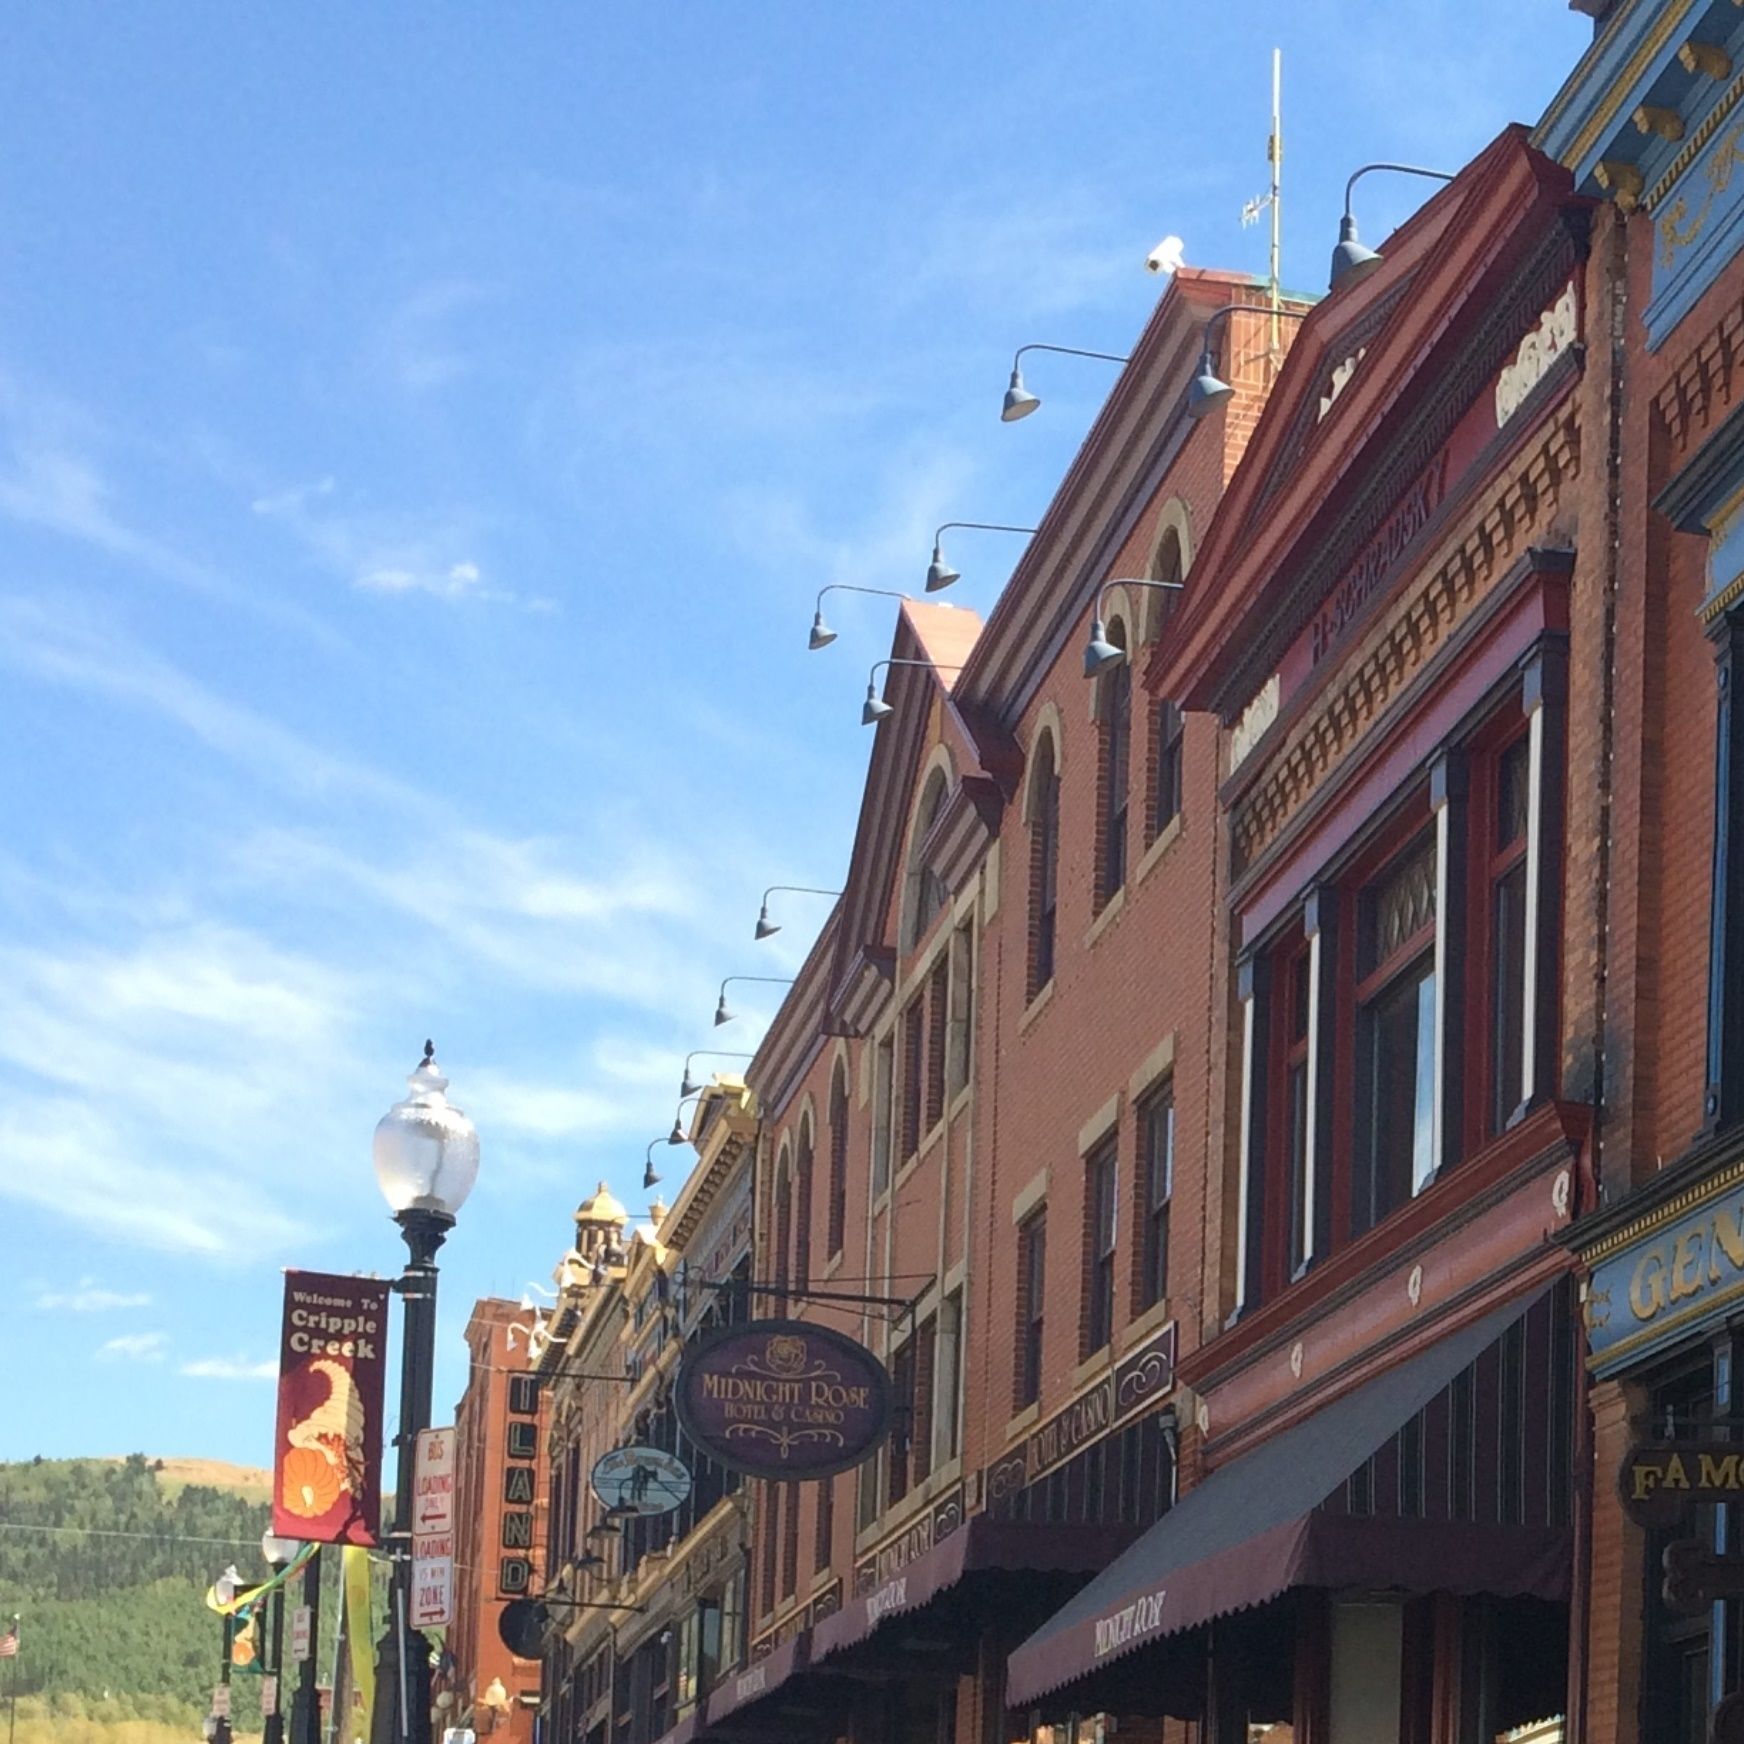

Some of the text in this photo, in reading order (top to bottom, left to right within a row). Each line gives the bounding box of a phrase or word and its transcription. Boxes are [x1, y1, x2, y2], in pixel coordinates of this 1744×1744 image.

[293, 1292, 378, 1310] Welcome To
[291, 1309, 377, 1335] Cripple
[290, 1332, 376, 1359] Creek
[702, 1373, 871, 1410] MIDNIGHT ROSE
[790, 1406, 844, 1425] CASINO
[416, 1474, 452, 1496] LOADING
[415, 1538, 452, 1561] LOADING
[419, 1585, 445, 1607] ZONE
